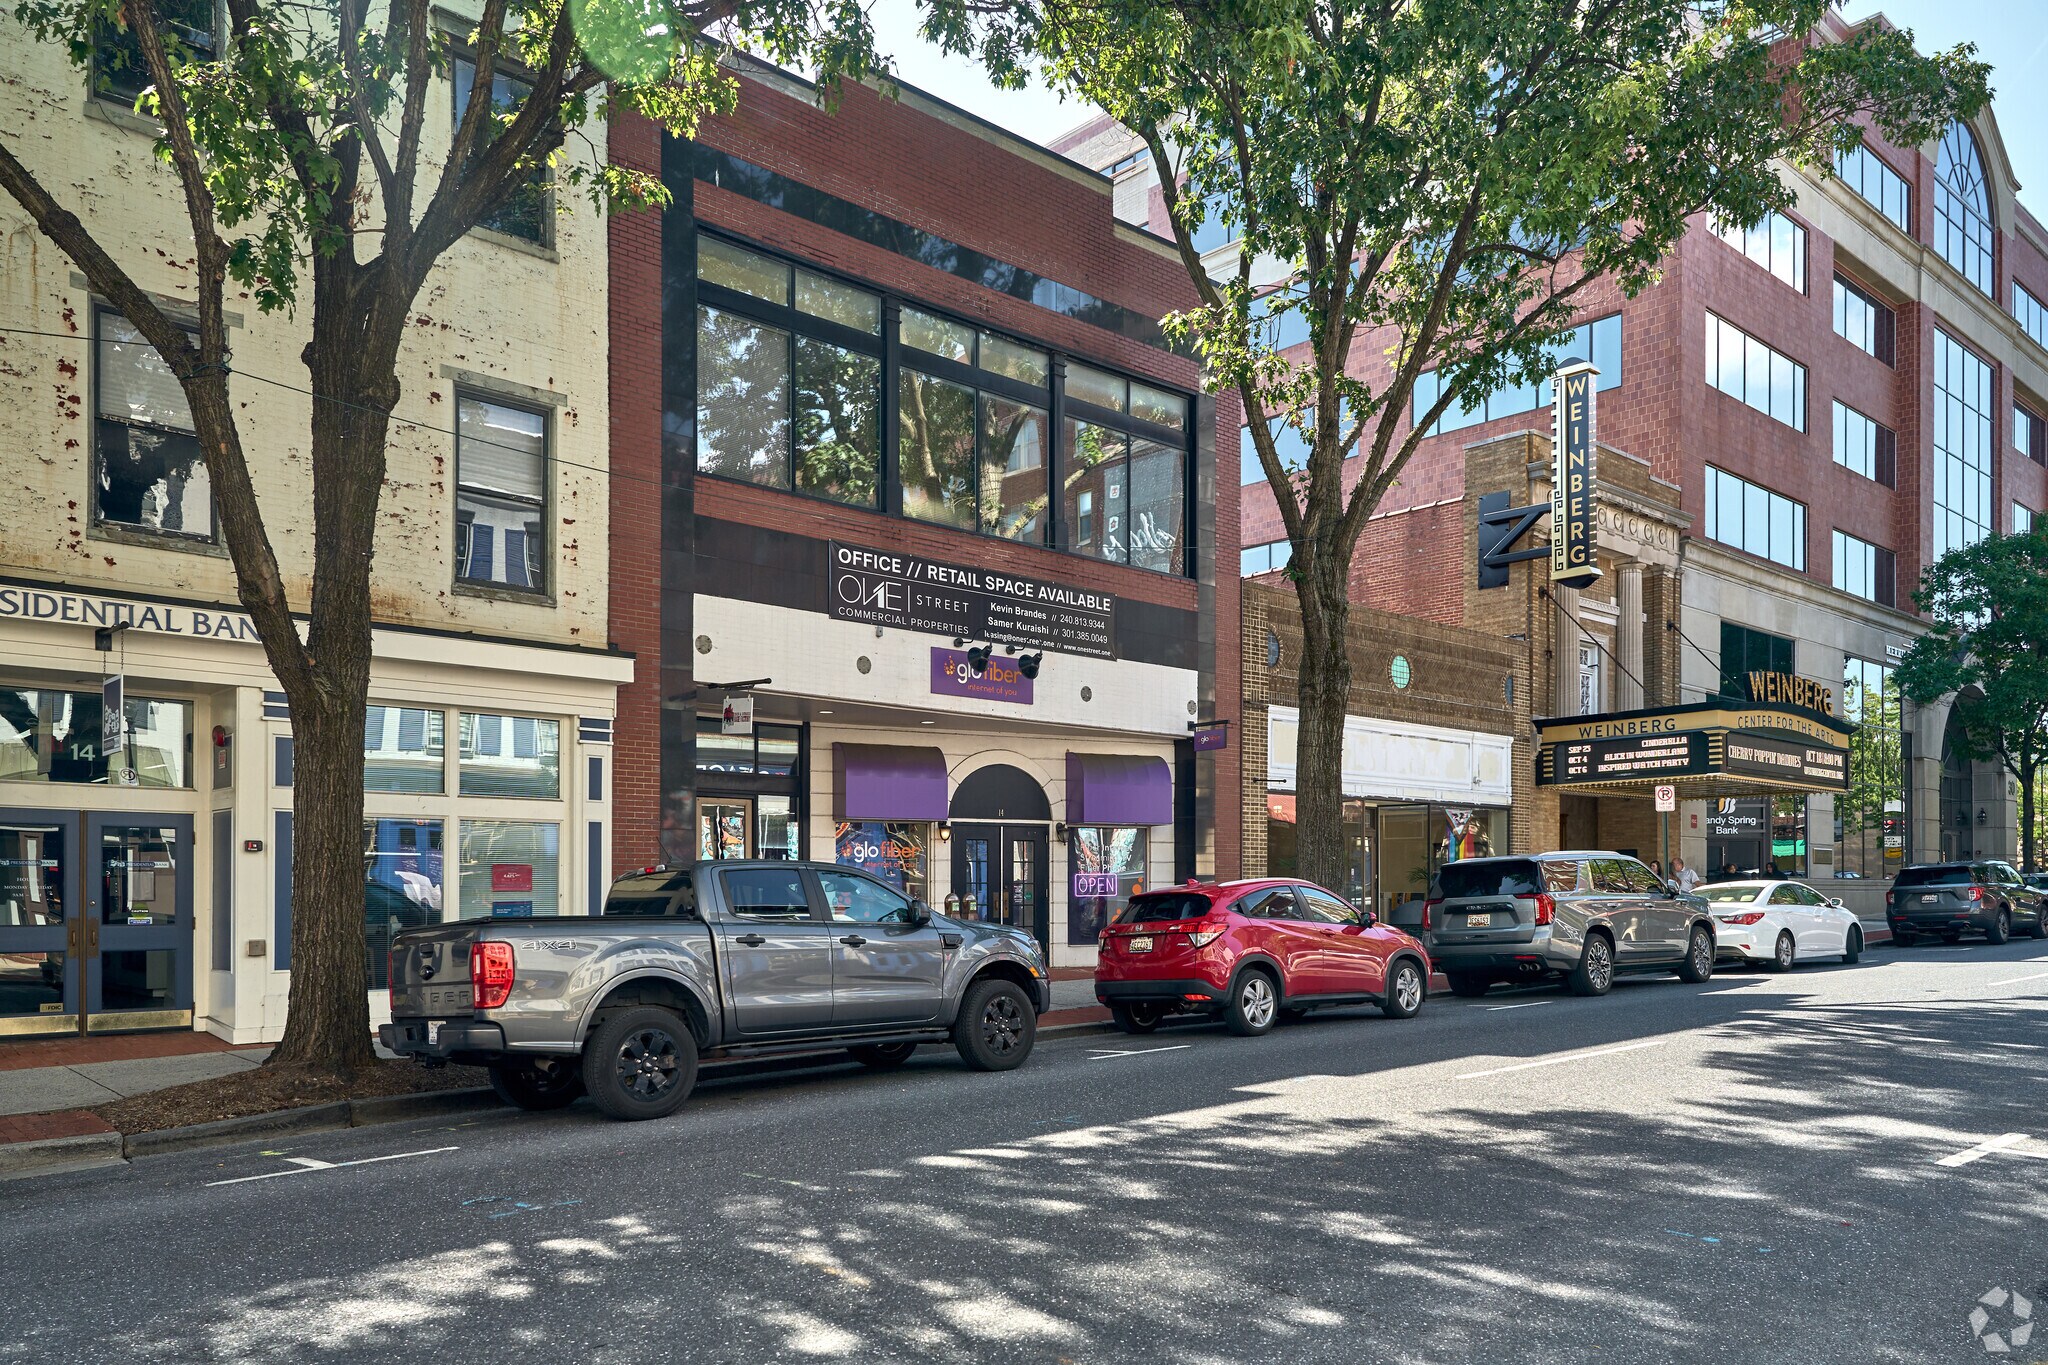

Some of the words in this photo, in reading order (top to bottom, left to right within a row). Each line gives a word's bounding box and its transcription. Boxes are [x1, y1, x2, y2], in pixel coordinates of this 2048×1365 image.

[1567, 376, 1588, 564] WEINBERG
[838, 548, 902, 574] OFFICE
[927, 564, 981, 589] RETAIL
[985, 576, 1034, 598] SPACE
[1038, 586, 1111, 612] AVAILABLE
[838, 574, 902, 612] ONE
[916, 594, 970, 613] STREET
[838, 606, 907, 626] COMMERCIAL
[910, 617, 969, 635] PROPERTIES
[990, 602, 1013, 615] Kevin
[1014, 607, 1047, 620] Brandes
[1060, 614, 1105, 630] 240.813.9344
[192, 611, 262, 643] BAN
[988, 617, 1014, 629] Samer
[1016, 621, 1049, 635] Kuraishi
[1062, 629, 1108, 644] 301.385.0049
[1063, 643, 1111, 657] www.onestreet.one
[968, 683, 995, 693] internet
[996, 686, 1003, 694] of
[1004, 689, 1017, 697] you
[1749, 670, 1833, 717] WEINBERG
[1579, 718, 1676, 738] WEINBERG
[1738, 715, 1772, 729] CENTER
[1776, 716, 1792, 730] FOR
[1797, 720, 1812, 734] THE
[1815, 727, 1835, 745] ARTS
[70, 743, 96, 762] 14
[1568, 746, 1582, 754] SEP
[1641, 736, 1688, 748] CINDERELLA
[1728, 745, 1754, 763] CHERRY
[1568, 756, 1582, 764] OCT
[1582, 755, 1588, 763] 4
[1604, 752, 1625, 761] ALICE
[1626, 751, 1634, 760] IN
[1635, 747, 1688, 759] WONDERLAND
[1805, 749, 1816, 762] OCT
[1568, 767, 1582, 775] OCT
[1598, 762, 1632, 773] INSPIRED
[1632, 760, 1661, 770] WATCH
[1661, 758, 1690, 767] PARTY
[2007, 780, 2016, 796] 30
[1706, 816, 1726, 826] andy
[1728, 816, 1757, 826] Spring
[1716, 826, 1739, 835] Bank
[1078, 877, 1115, 893] OPEN
